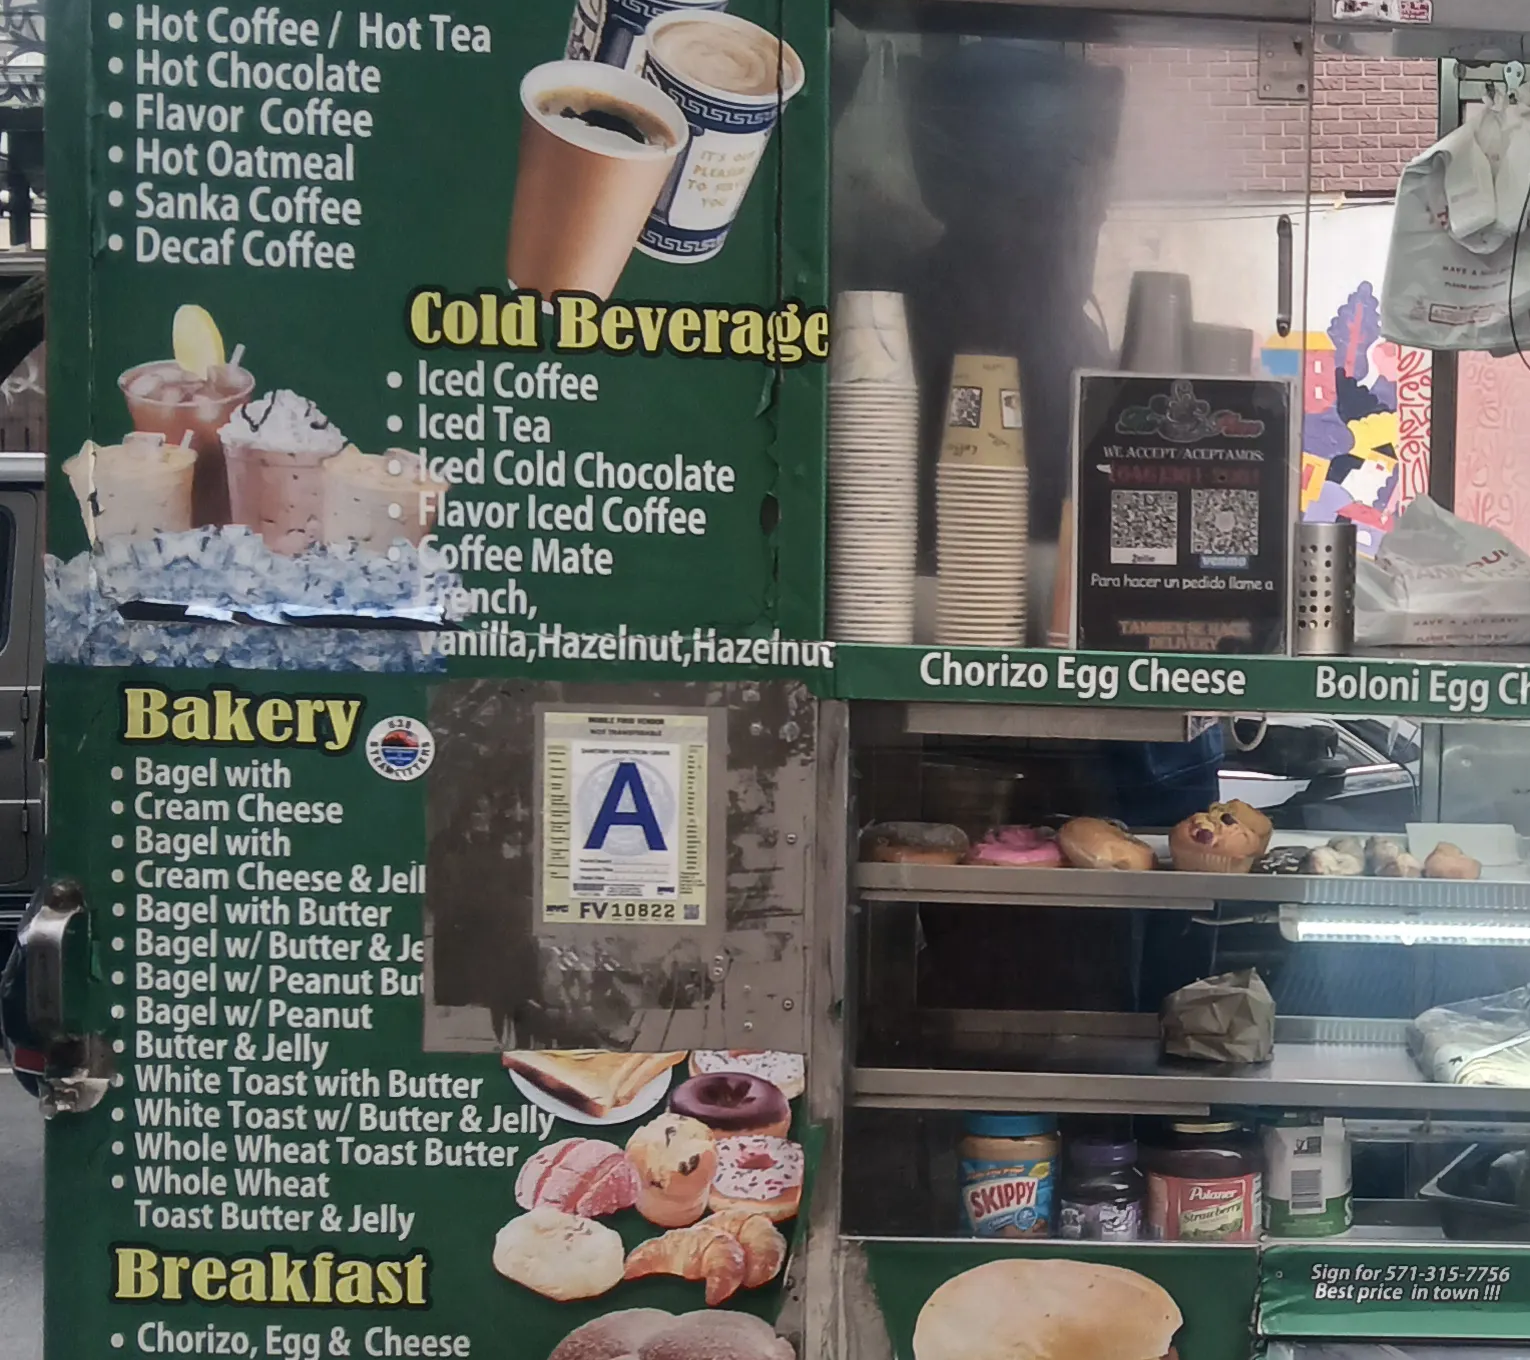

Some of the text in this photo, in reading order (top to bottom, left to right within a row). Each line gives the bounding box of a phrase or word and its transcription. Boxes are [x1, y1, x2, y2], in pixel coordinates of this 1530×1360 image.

[135, 4, 491, 53] Hot Coffee / Hot Tea
[135, 49, 381, 94] Hot Chocolate
[135, 138, 354, 181] Hot Oatmeal
[135, 182, 361, 226] Sanka Coffee
[135, 226, 356, 270] Decaf Coffee
[411, 291, 828, 362] Cold Beverage
[418, 360, 598, 401] Iced Coffee
[418, 535, 613, 575] Coffee Mate
[1091, 573, 1273, 590] Para hacer un pedido llame a
[920, 652, 1246, 701] Chorizo Egg Cheese
[1316, 667, 1420, 702] Boloni
[1429, 671, 1489, 711] Egg
[124, 687, 361, 750] Bakery
[135, 757, 291, 794] Bagel with
[134, 792, 343, 824] Cream Cheese
[583, 762, 668, 850] A
[134, 1065, 483, 1101] White Toast with Butter
[970, 1181, 1035, 1218] SKIPPY
[115, 1247, 427, 1305] Breakfast
[1311, 1264, 1510, 1284] Sign for 571-315-7756
[1315, 1283, 1501, 1303] Best price in town !!!
[138, 1321, 259, 1359] Chorizo,
[329, 1328, 350, 1357] &
[364, 1328, 471, 1358] Cheese
